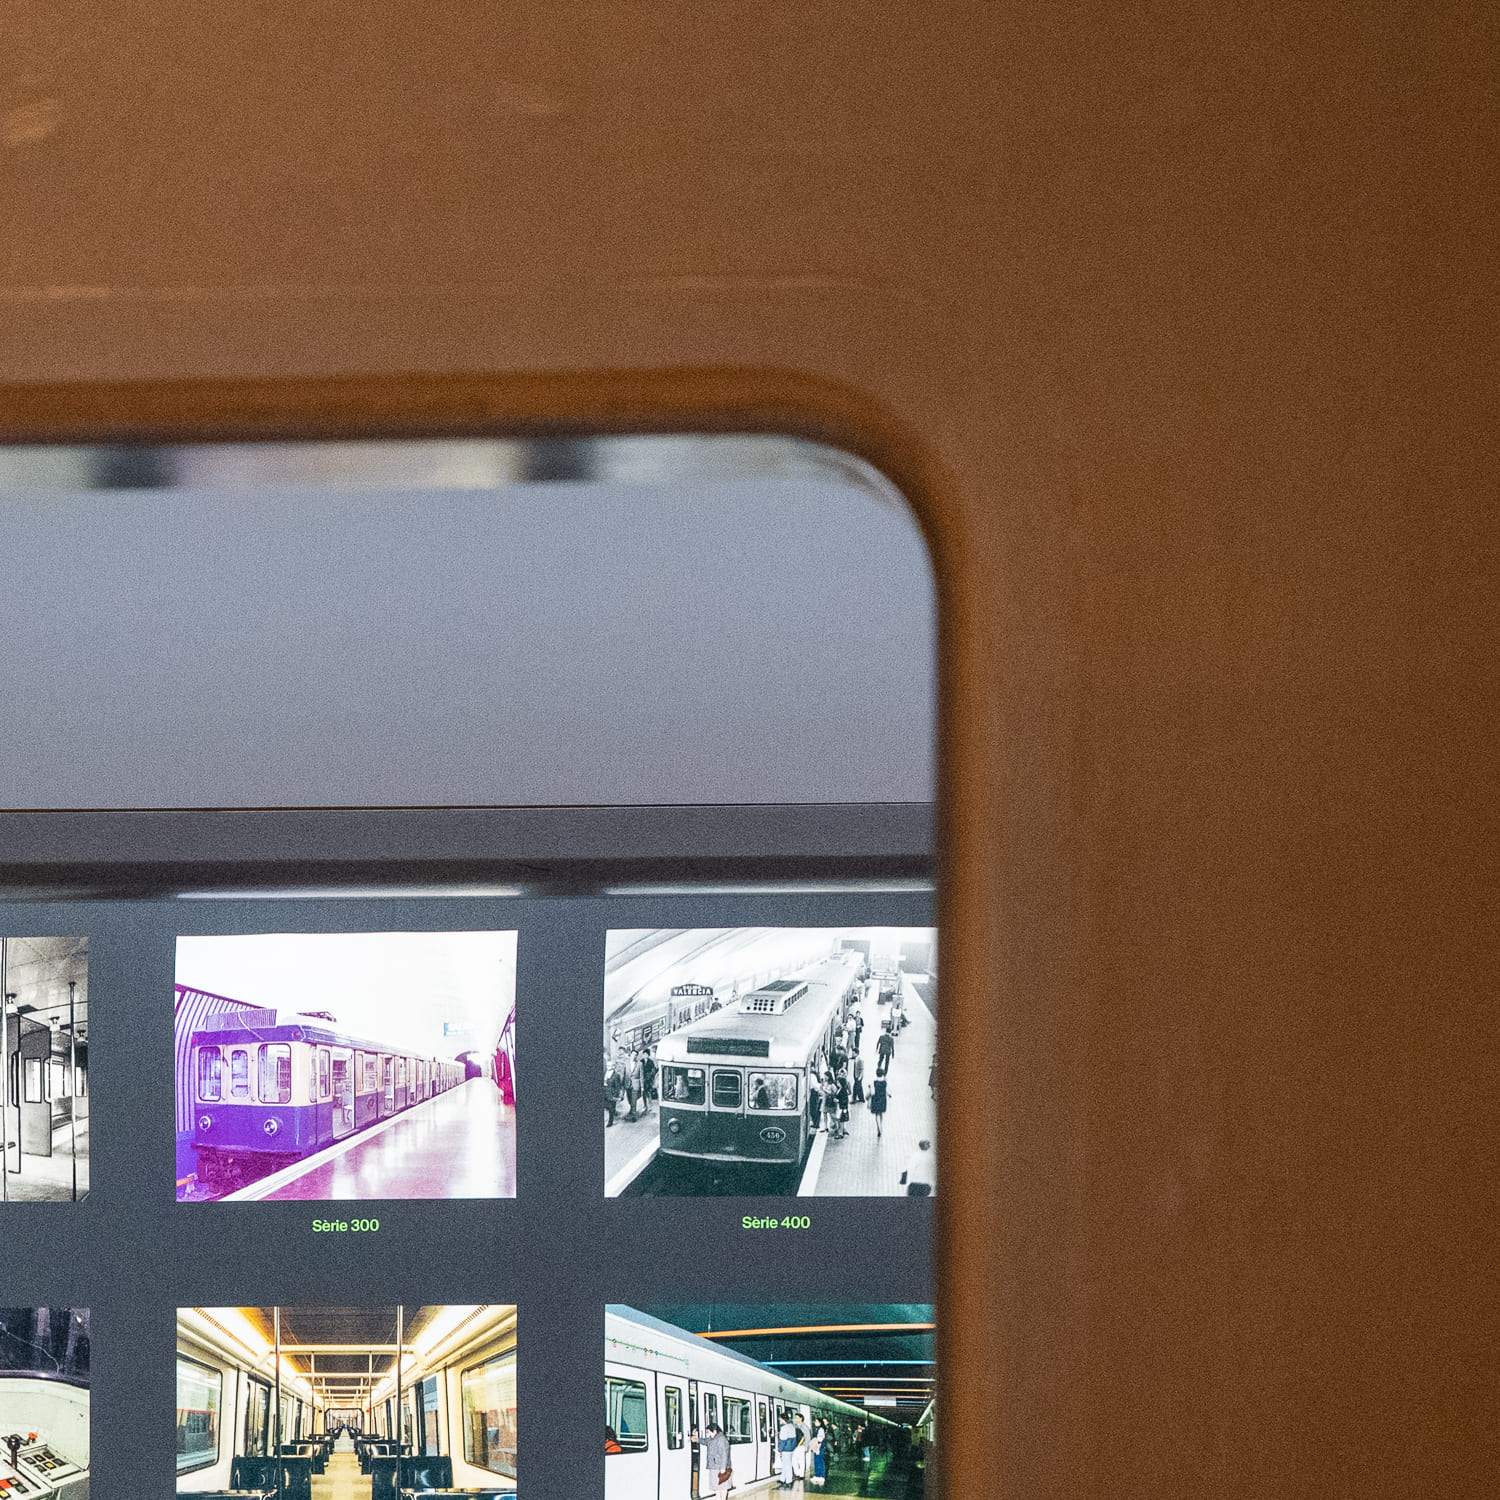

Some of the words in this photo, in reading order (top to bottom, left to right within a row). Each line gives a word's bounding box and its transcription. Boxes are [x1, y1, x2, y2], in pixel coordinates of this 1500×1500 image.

[311, 1218, 349, 1233] Sèrie
[350, 1218, 381, 1233] 300
[741, 1215, 779, 1230] Sèrie
[780, 1215, 812, 1230] 400
